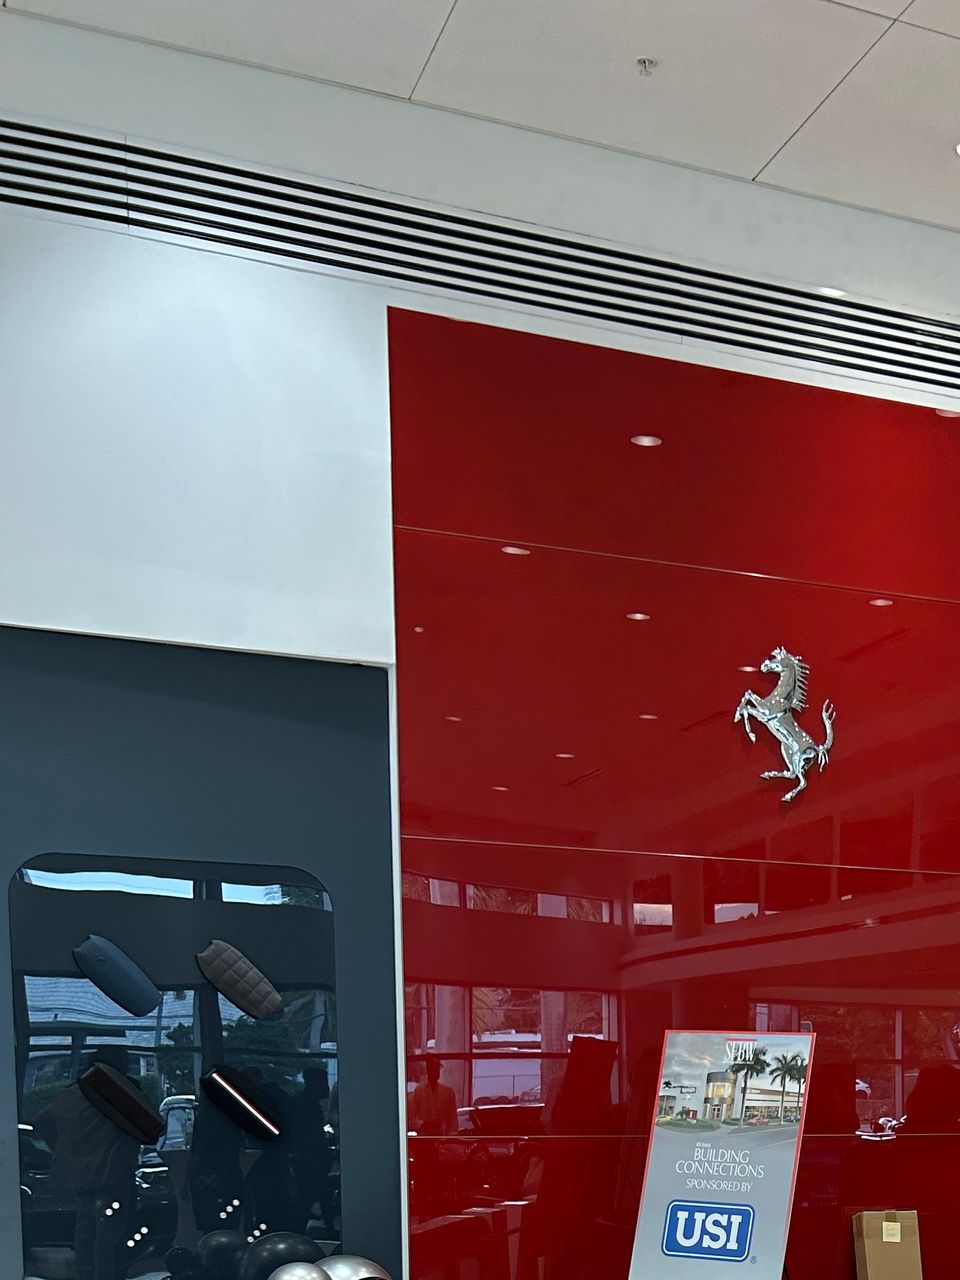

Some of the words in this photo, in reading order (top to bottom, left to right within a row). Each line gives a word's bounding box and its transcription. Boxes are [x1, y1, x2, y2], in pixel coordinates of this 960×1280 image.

[724, 1041, 758, 1061] SFBW
[694, 1147, 750, 1164] BUILDING
[676, 1160, 765, 1178] CONNECTIONS
[686, 1178, 740, 1191] SPONSORED
[741, 1182, 753, 1192] BY
[676, 1210, 742, 1250] USI
